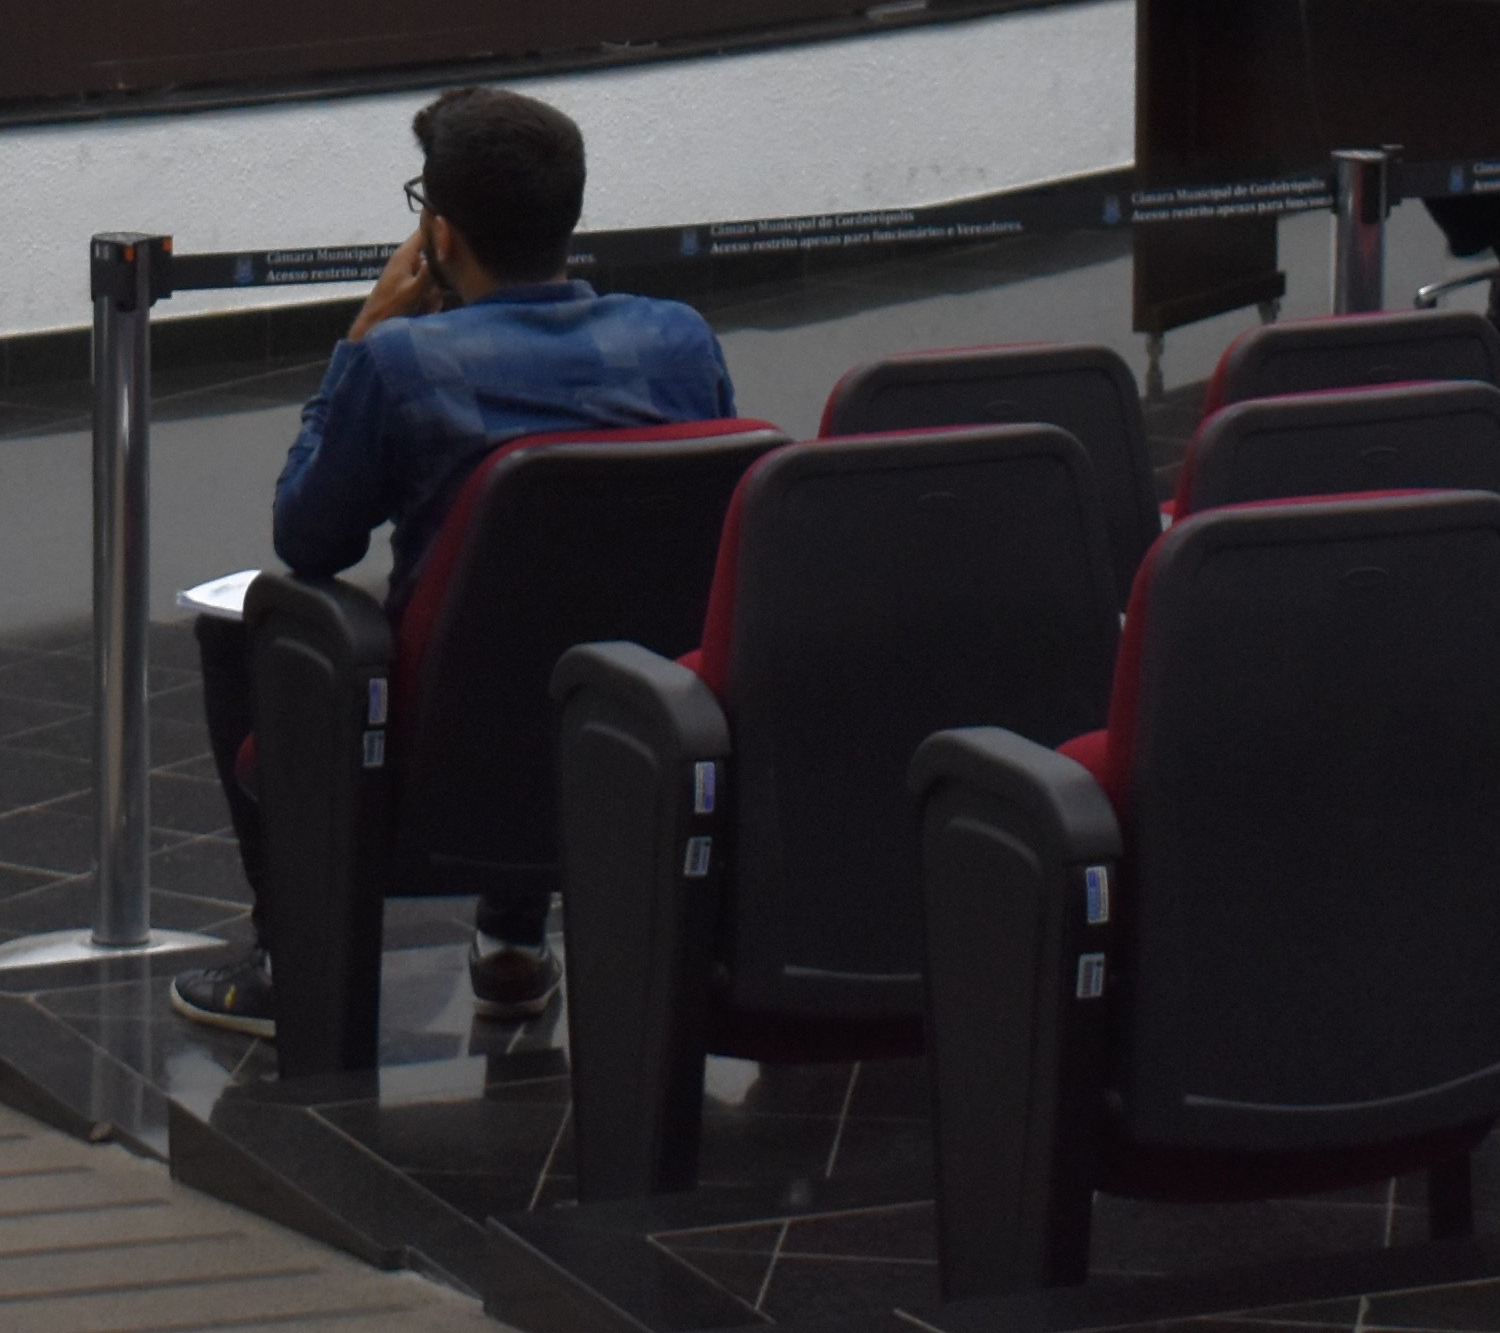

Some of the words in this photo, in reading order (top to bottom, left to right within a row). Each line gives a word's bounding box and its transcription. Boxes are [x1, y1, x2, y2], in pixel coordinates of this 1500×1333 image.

[710, 223, 756, 236] Câmara
[758, 217, 816, 233] Municipal
[818, 216, 833, 228] de
[710, 241, 751, 254] Acesso
[753, 236, 798, 251] restrito
[799, 236, 842, 251] apenas
[843, 232, 871, 247] para
[266, 250, 314, 264] Câmara
[316, 245, 379, 261] Municipal
[266, 269, 309, 282] Acesso
[311, 265, 358, 280] restrito
